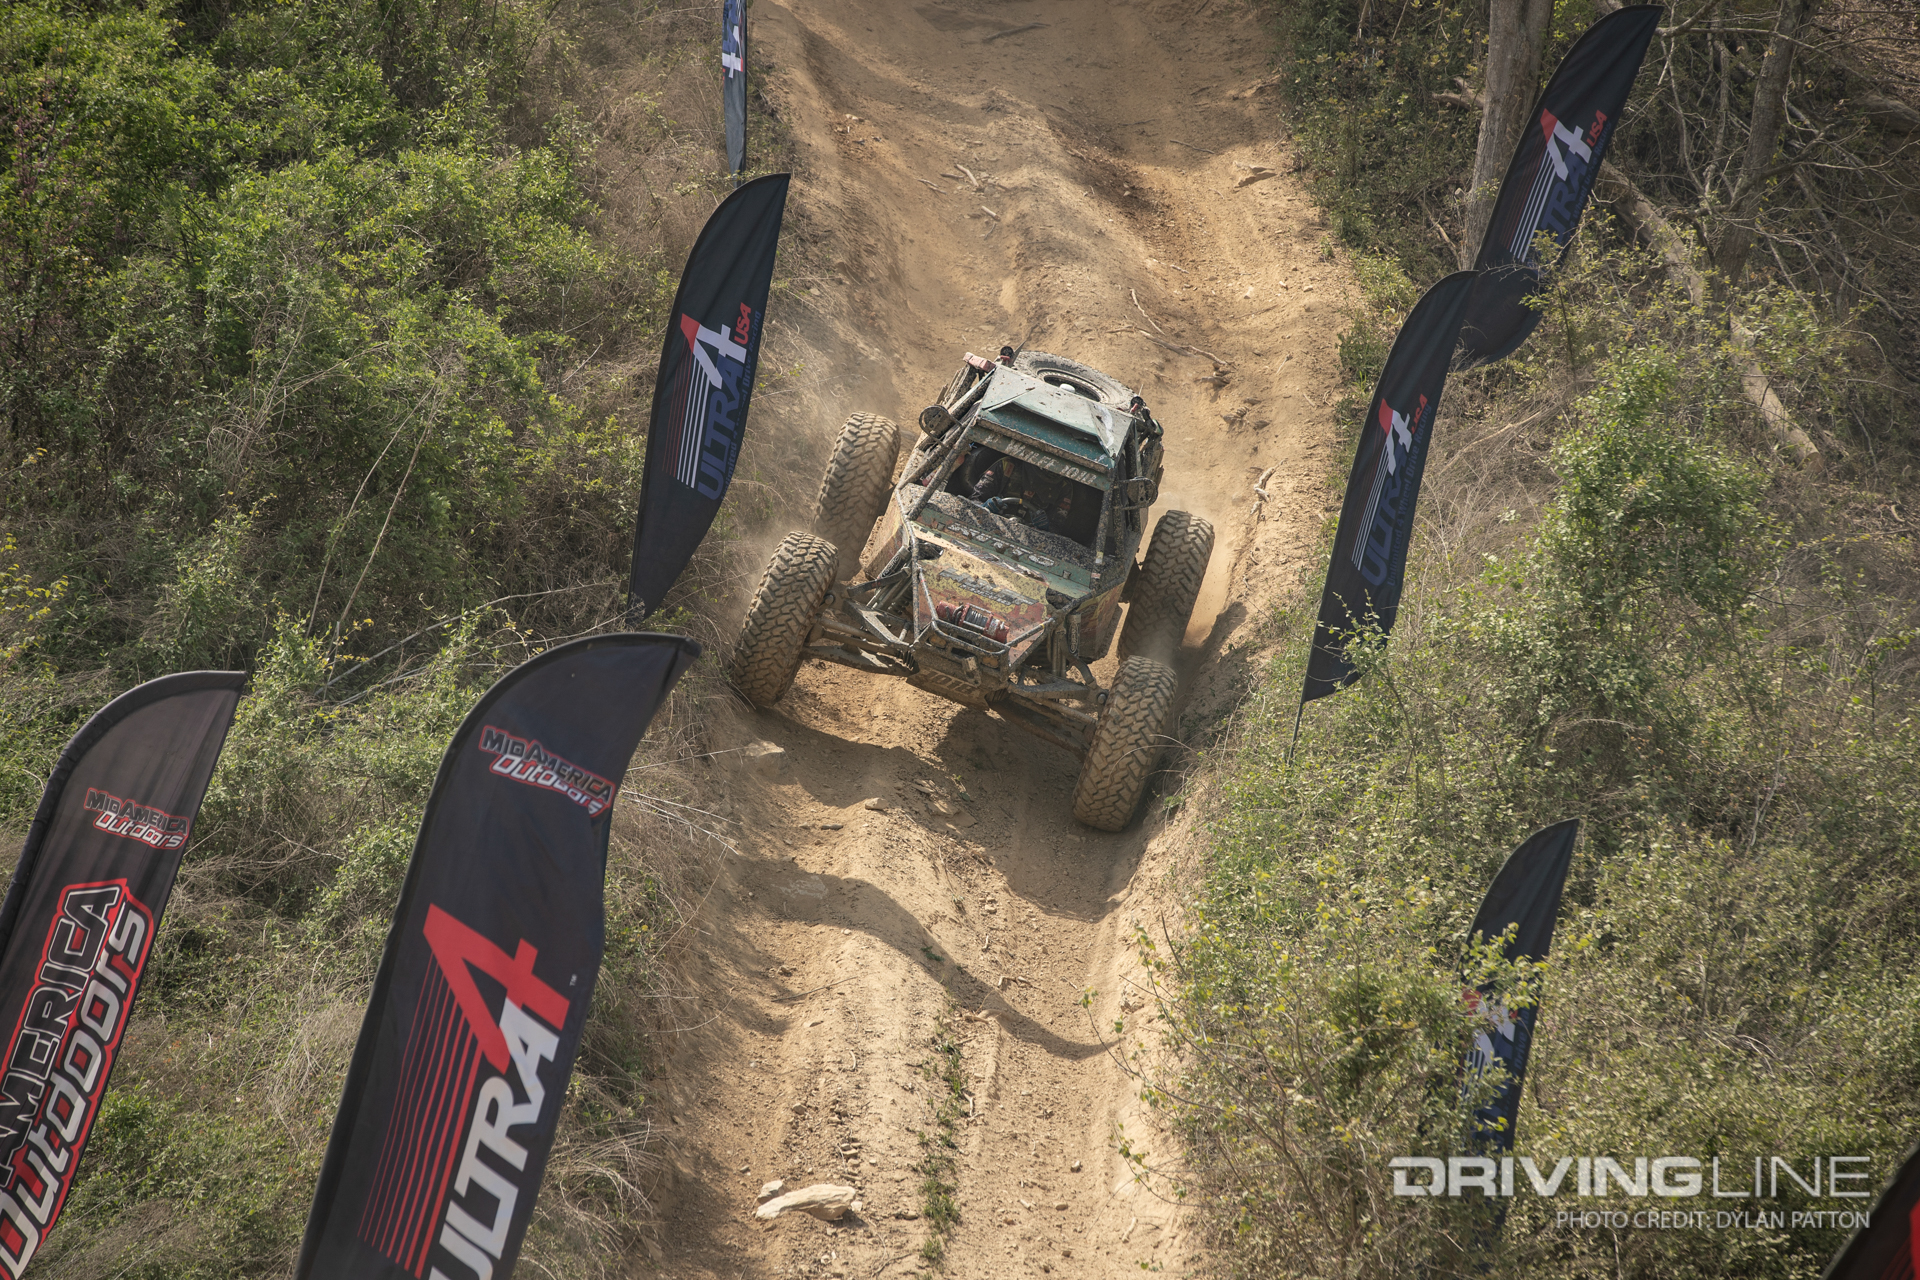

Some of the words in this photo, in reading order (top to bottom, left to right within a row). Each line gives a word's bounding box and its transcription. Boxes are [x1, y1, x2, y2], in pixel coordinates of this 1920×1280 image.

[1587, 110, 1607, 147] USA
[734, 302, 751, 345] USA
[742, 355, 751, 388] Drive
[1387, 530, 1403, 586] Unlimited
[1398, 478, 1413, 515] Wheel
[1406, 446, 1420, 478] Drive
[1414, 404, 1432, 444] Racing
